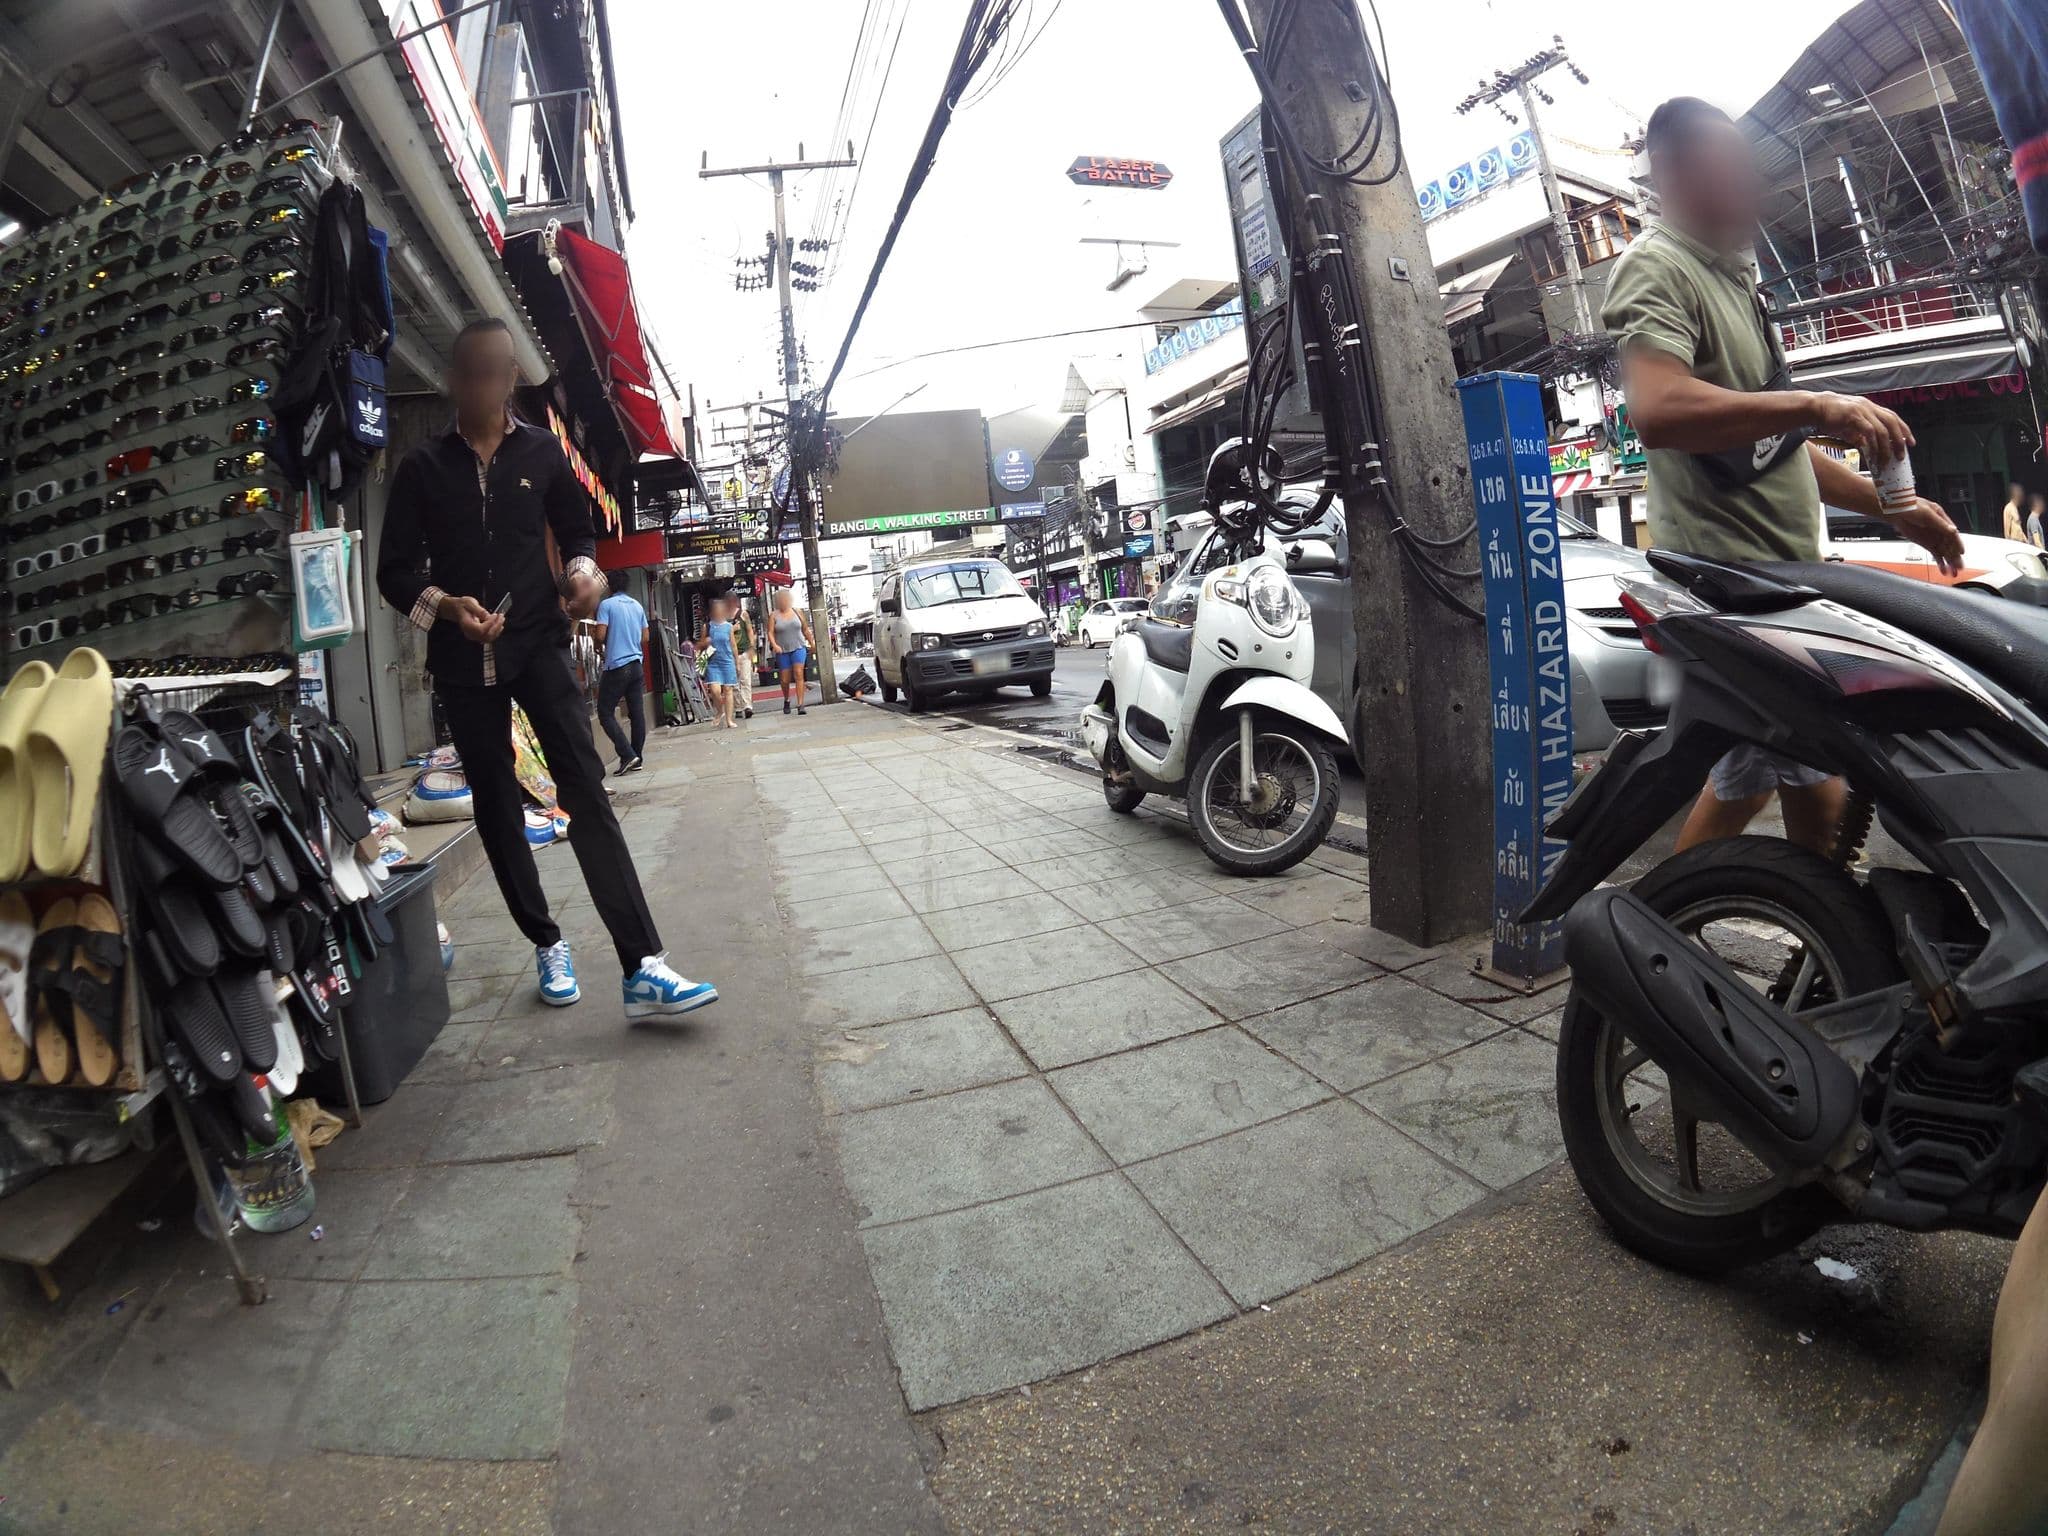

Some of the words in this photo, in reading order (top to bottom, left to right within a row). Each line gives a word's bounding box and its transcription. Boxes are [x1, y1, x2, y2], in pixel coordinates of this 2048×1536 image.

[1089, 157, 1155, 171] LASER
[1088, 170, 1161, 184] BATTLE
[1755, 434, 1778, 456] NIKE
[1480, 476, 1506, 504] เขต
[830, 519, 880, 535] BANGLA
[884, 513, 941, 529] WALKING
[945, 508, 989, 523] STREET
[1521, 475, 1558, 579] ZONE
[703, 545, 726, 553] HOTEL
[720, 537, 739, 546] STAR
[1535, 600, 1568, 762] HAZARD
